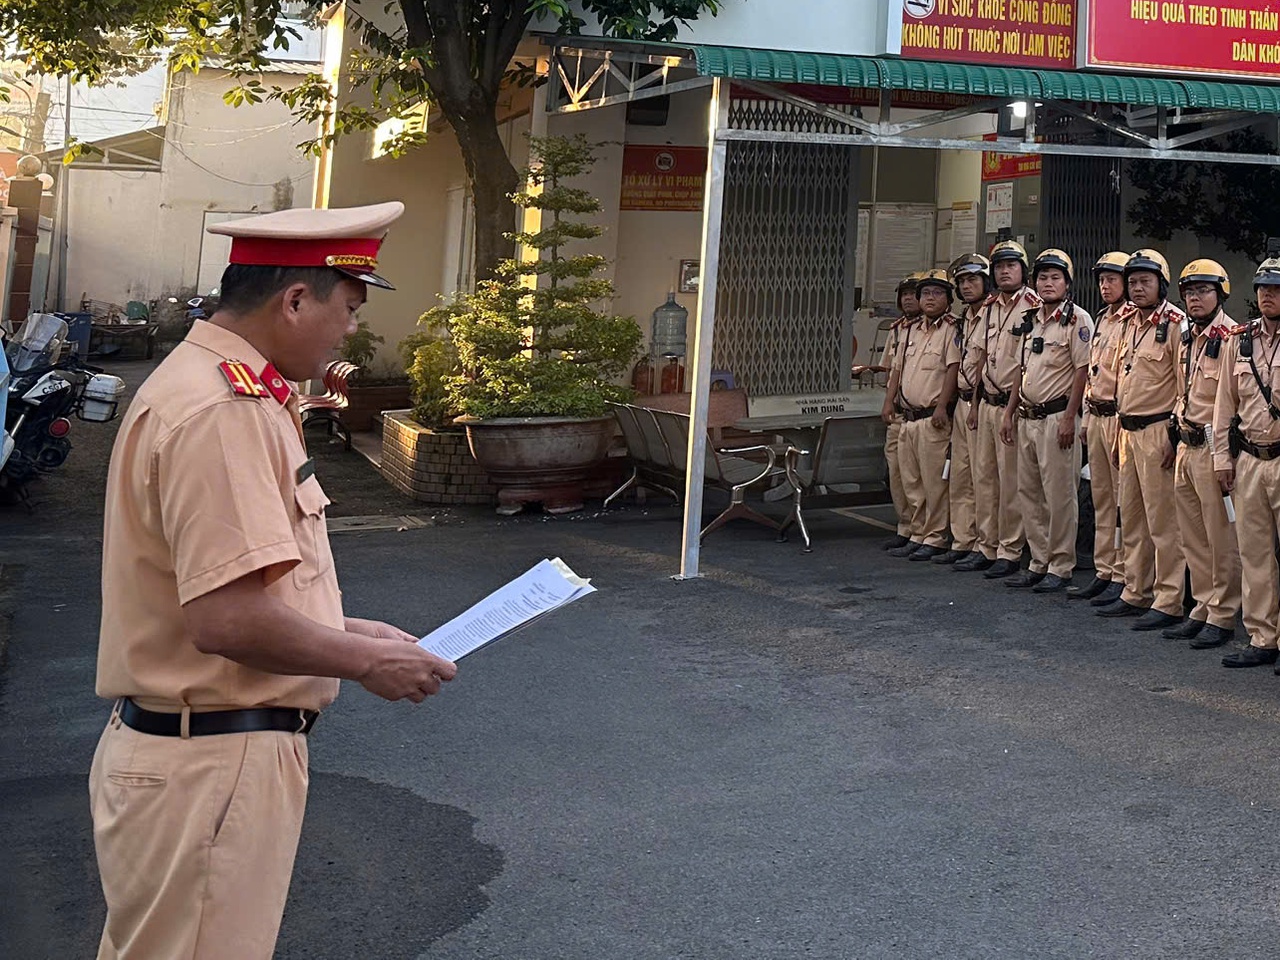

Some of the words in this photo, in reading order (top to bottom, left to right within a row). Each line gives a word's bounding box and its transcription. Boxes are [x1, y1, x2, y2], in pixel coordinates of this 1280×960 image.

[1188, 4, 1217, 27] THEO
[1220, 7, 1246, 29] TINH
[1249, 5, 1279, 31] THẦN
[901, 21, 940, 49] KHÔNG
[943, 24, 964, 51] HÚT
[967, 25, 1000, 54] THUỐC
[1003, 31, 1020, 56] NƠI
[1023, 30, 1044, 57] LÀM
[1047, 33, 1071, 61] VIỆC
[1232, 38, 1256, 62] DÂN
[1259, 41, 1280, 65] KHÓ
[42, 382, 65, 395] CSGT
[801, 406, 818, 415] KIM
[820, 404, 845, 414] DUNG
